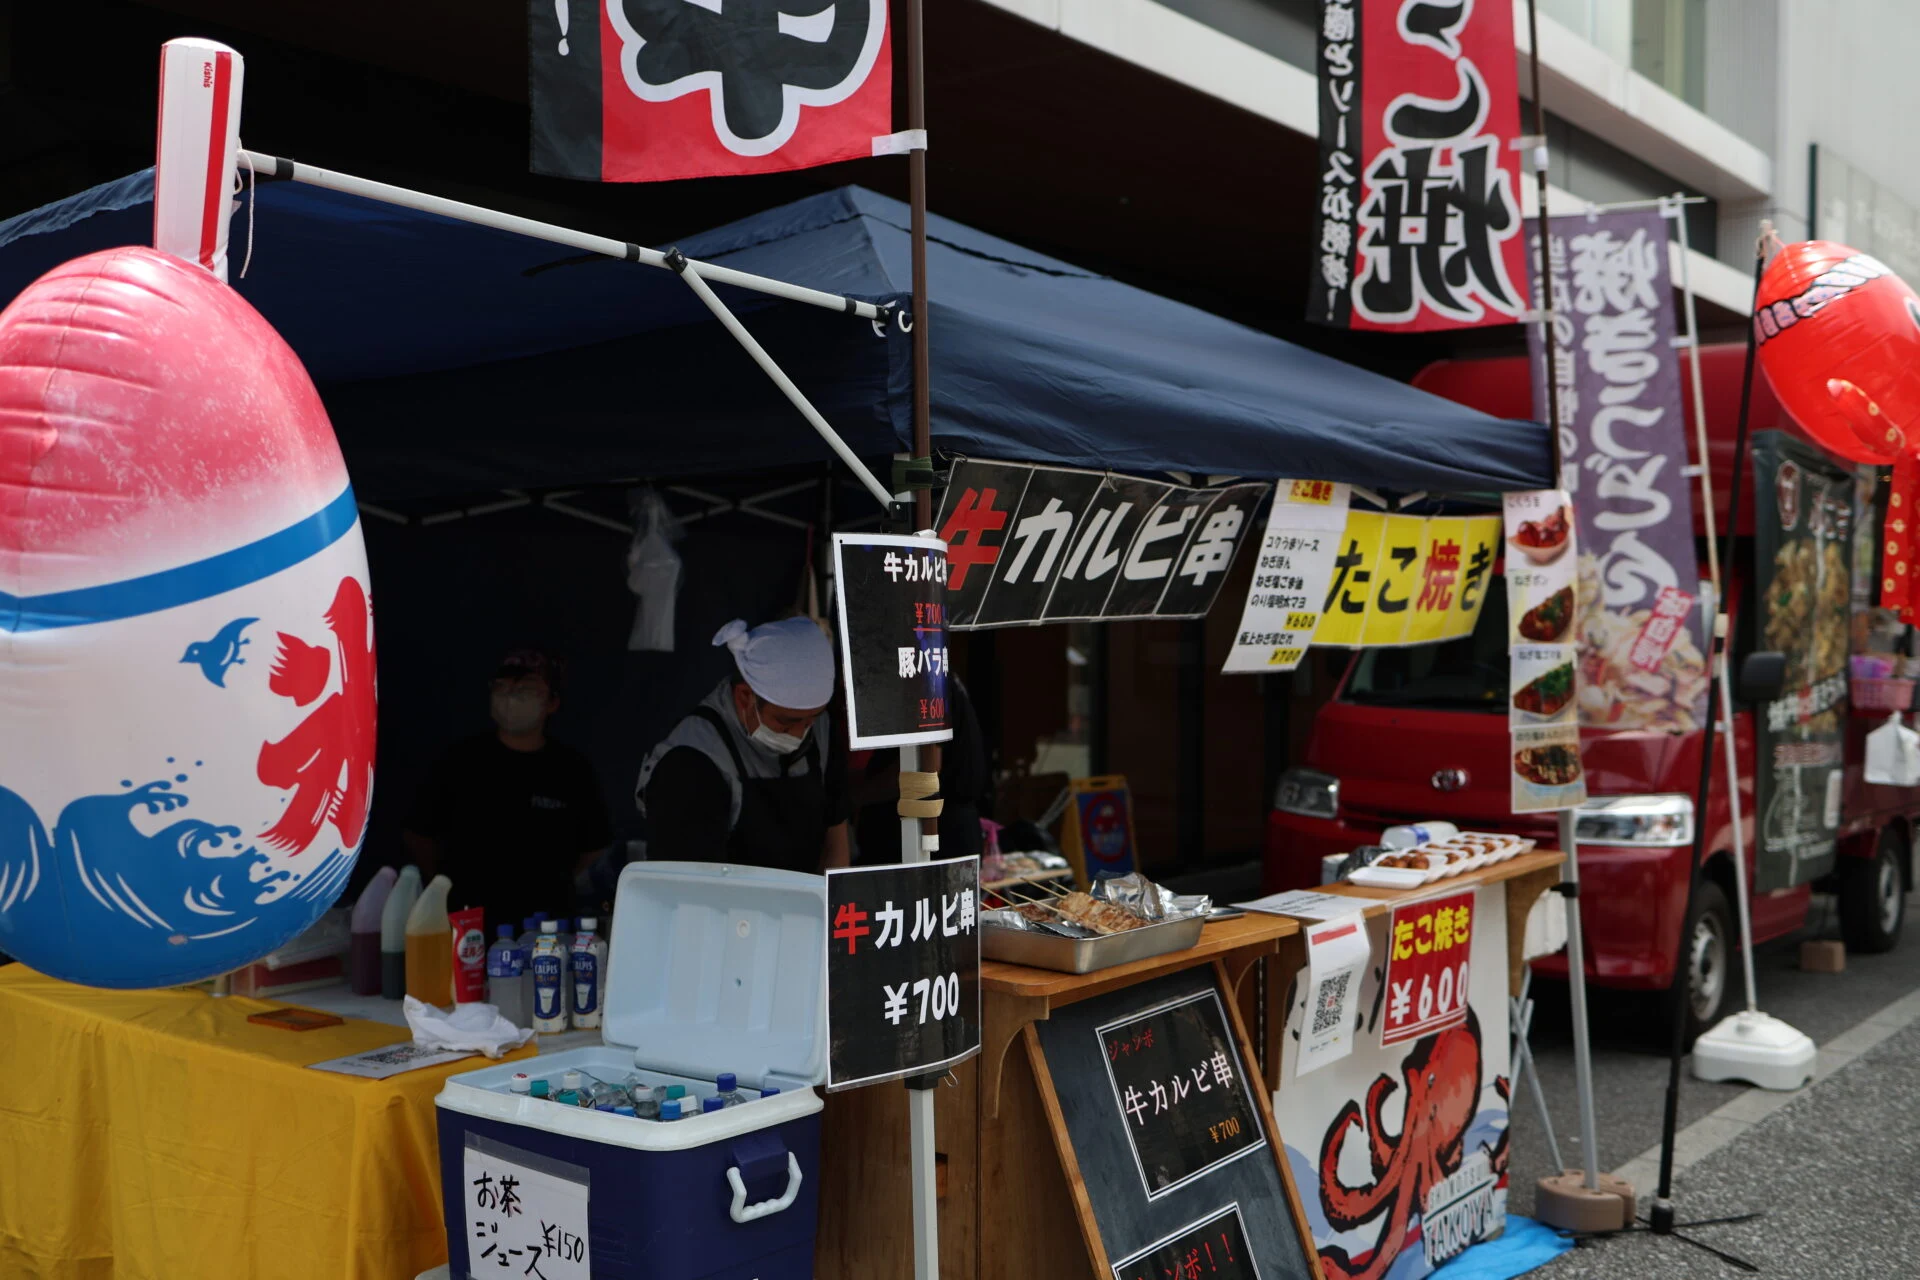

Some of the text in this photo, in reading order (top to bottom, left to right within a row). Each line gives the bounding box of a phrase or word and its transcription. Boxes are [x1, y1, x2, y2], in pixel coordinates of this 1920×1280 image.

[938, 487, 1245, 591] 牛カルビ串
[1322, 538, 1491, 614] たこ焼き
[914, 602, 942, 624] ¥700
[1286, 614, 1316, 628] ¥600
[833, 887, 975, 955] 牛カルビ串
[1392, 905, 1470, 962] たこ焼き
[883, 971, 960, 1026] ¥700
[1390, 960, 1468, 1025] ¥600
[1124, 1051, 1234, 1126] 牛カルビ串
[1209, 1116, 1240, 1144] ¥700
[473, 1170, 523, 1218] お茶
[540, 1219, 585, 1264] ¥150
